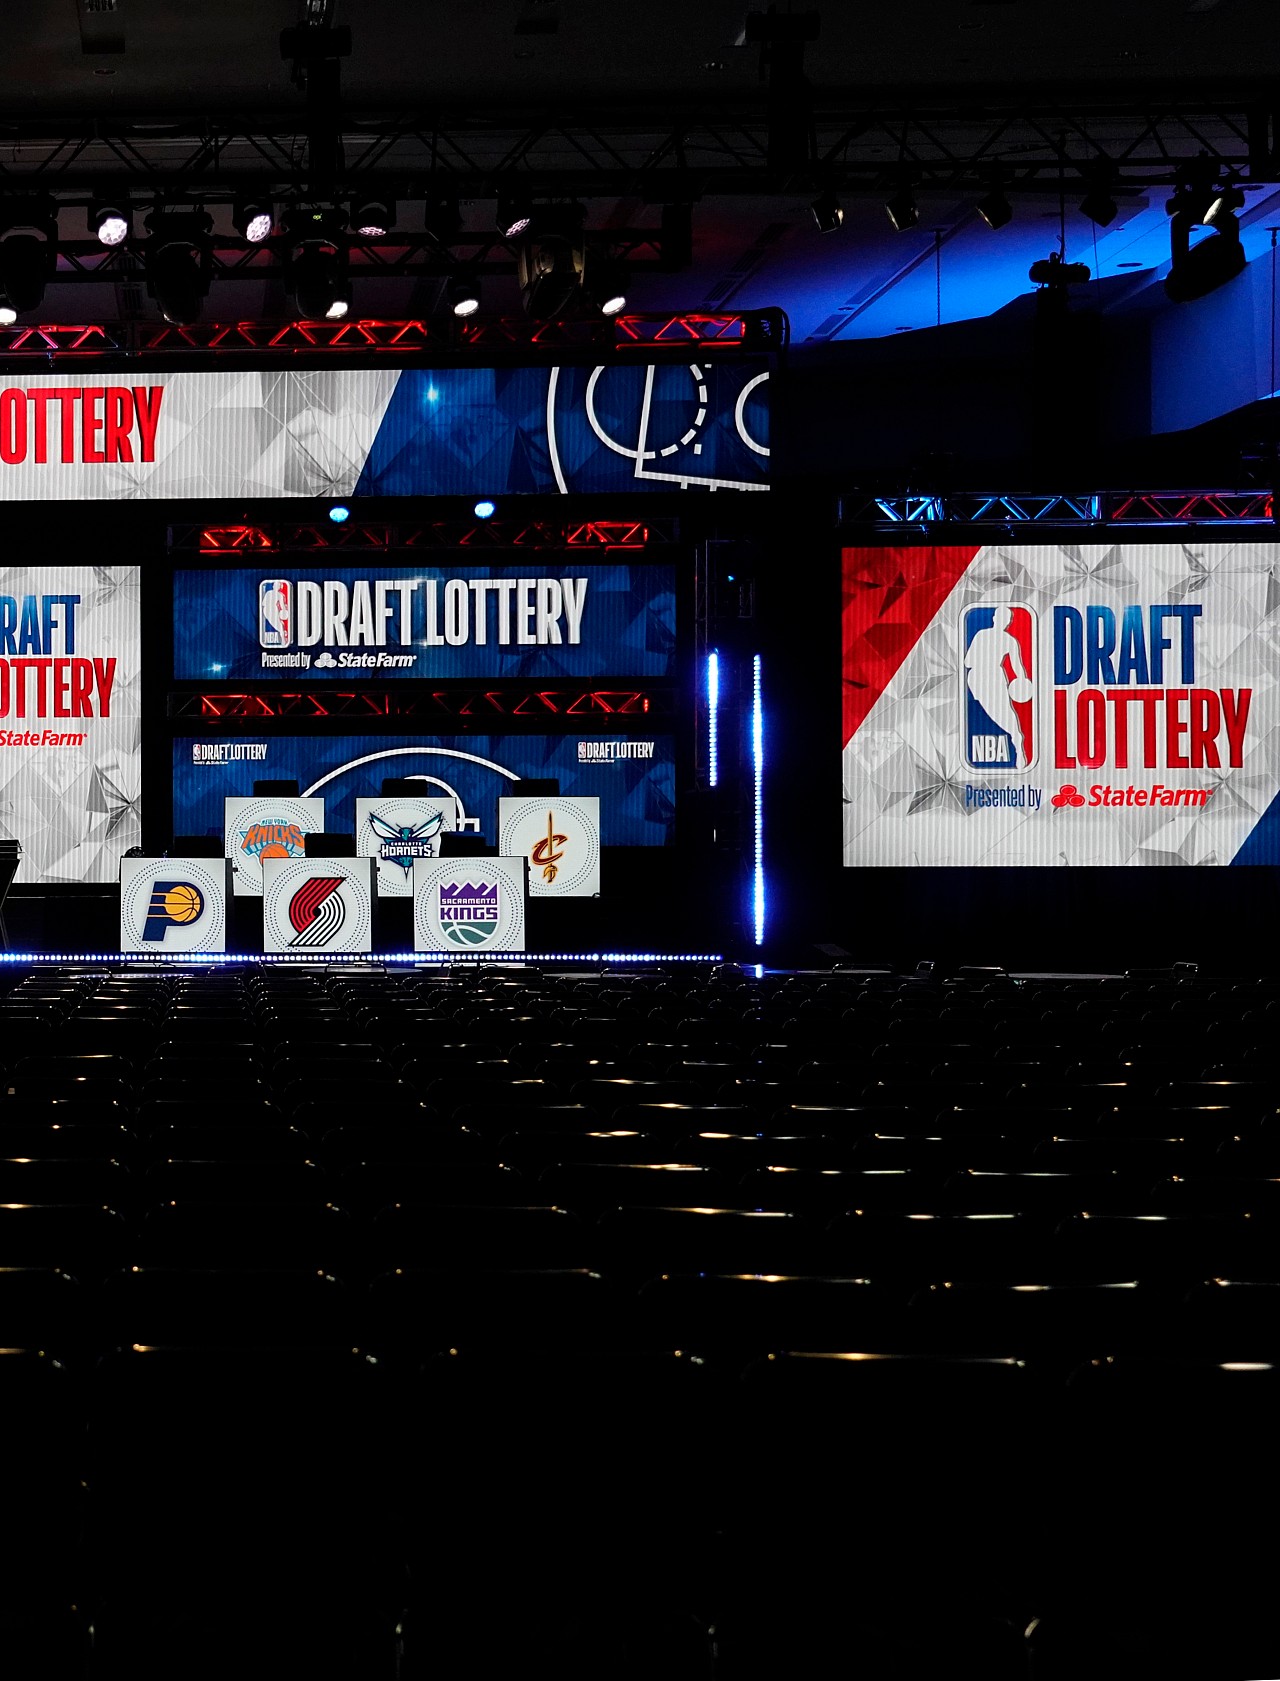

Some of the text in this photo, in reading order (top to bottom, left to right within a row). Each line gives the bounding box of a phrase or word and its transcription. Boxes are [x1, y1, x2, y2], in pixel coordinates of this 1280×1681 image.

[297, 578, 588, 646] DRAFT LOTTERY
[1054, 604, 1202, 685] DRAFT
[262, 652, 300, 667] Presented
[301, 652, 311, 670] by
[1054, 689, 1252, 769] LOTTERY
[202, 744, 267, 760] DRAFT LOTTERY
[587, 742, 654, 758] DRAFT LOTTERY
[972, 735, 1010, 763] NBA
[966, 785, 1025, 807] Presented
[1028, 785, 1041, 810] by
[241, 824, 305, 849] KNICKS
[382, 845, 432, 857] HORNETS
[440, 907, 498, 920] KINGS
